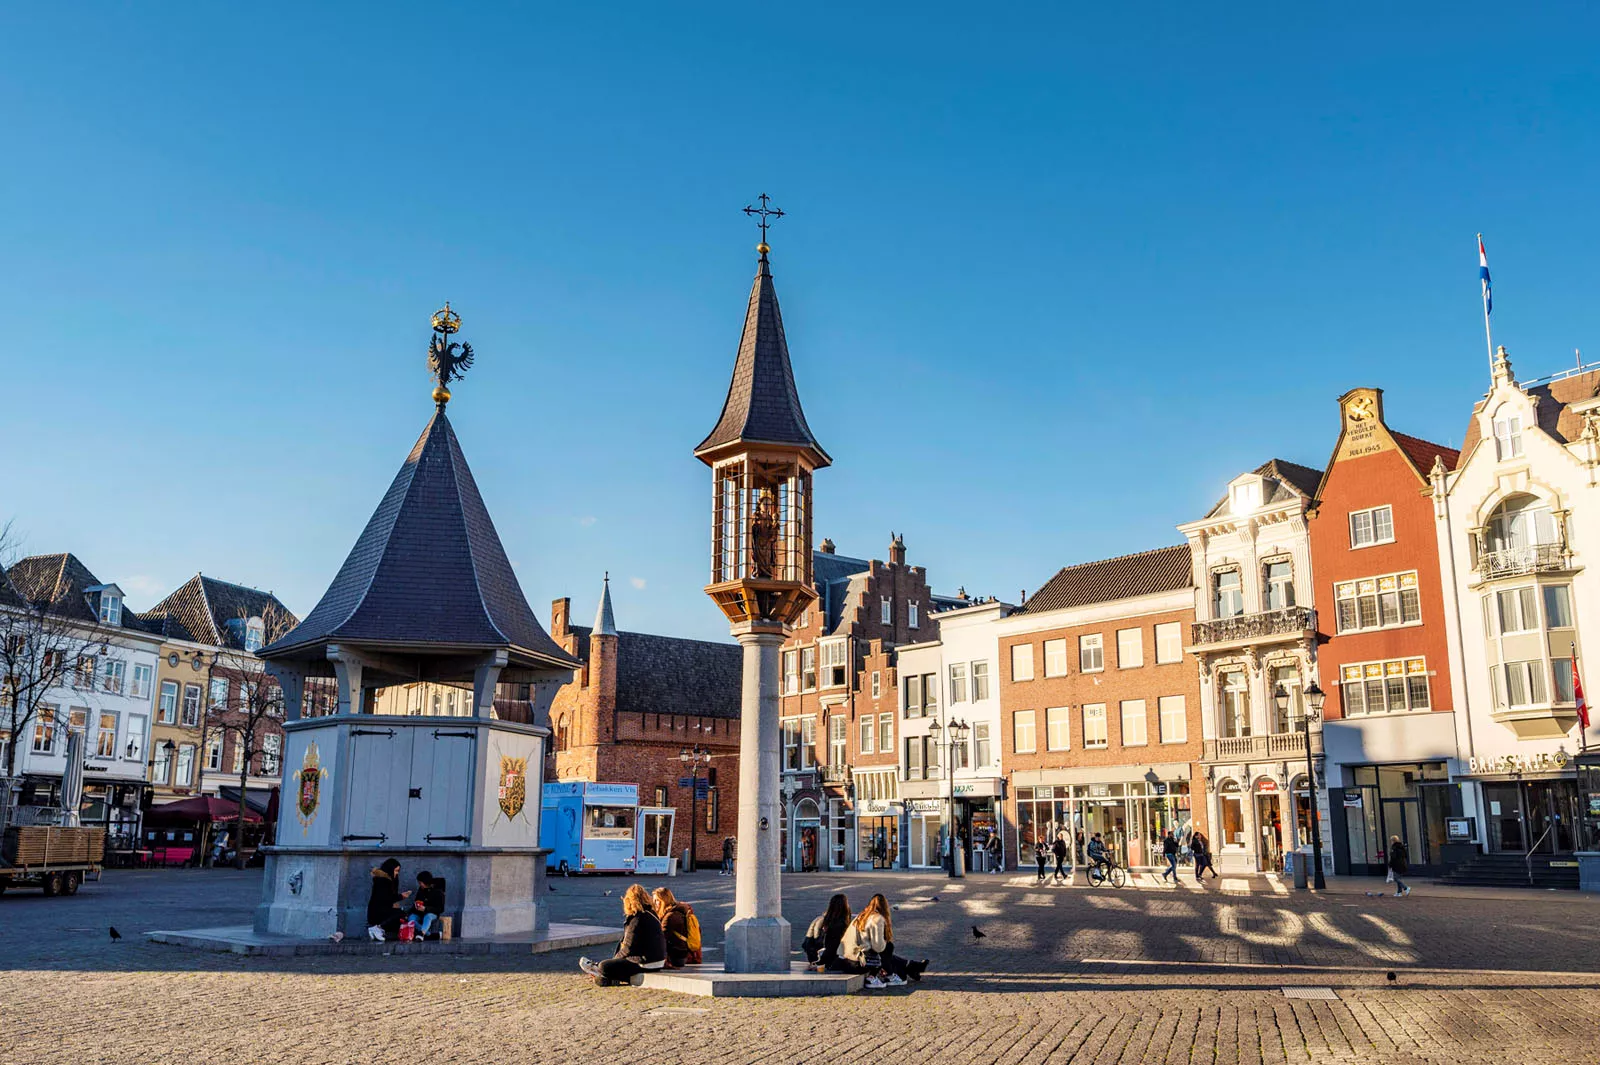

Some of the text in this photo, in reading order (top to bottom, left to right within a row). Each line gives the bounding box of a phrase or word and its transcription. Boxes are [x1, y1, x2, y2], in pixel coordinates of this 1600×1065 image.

[1469, 753, 1549, 773] BRASSERIE
[587, 784, 636, 793] Gebakken Vis
